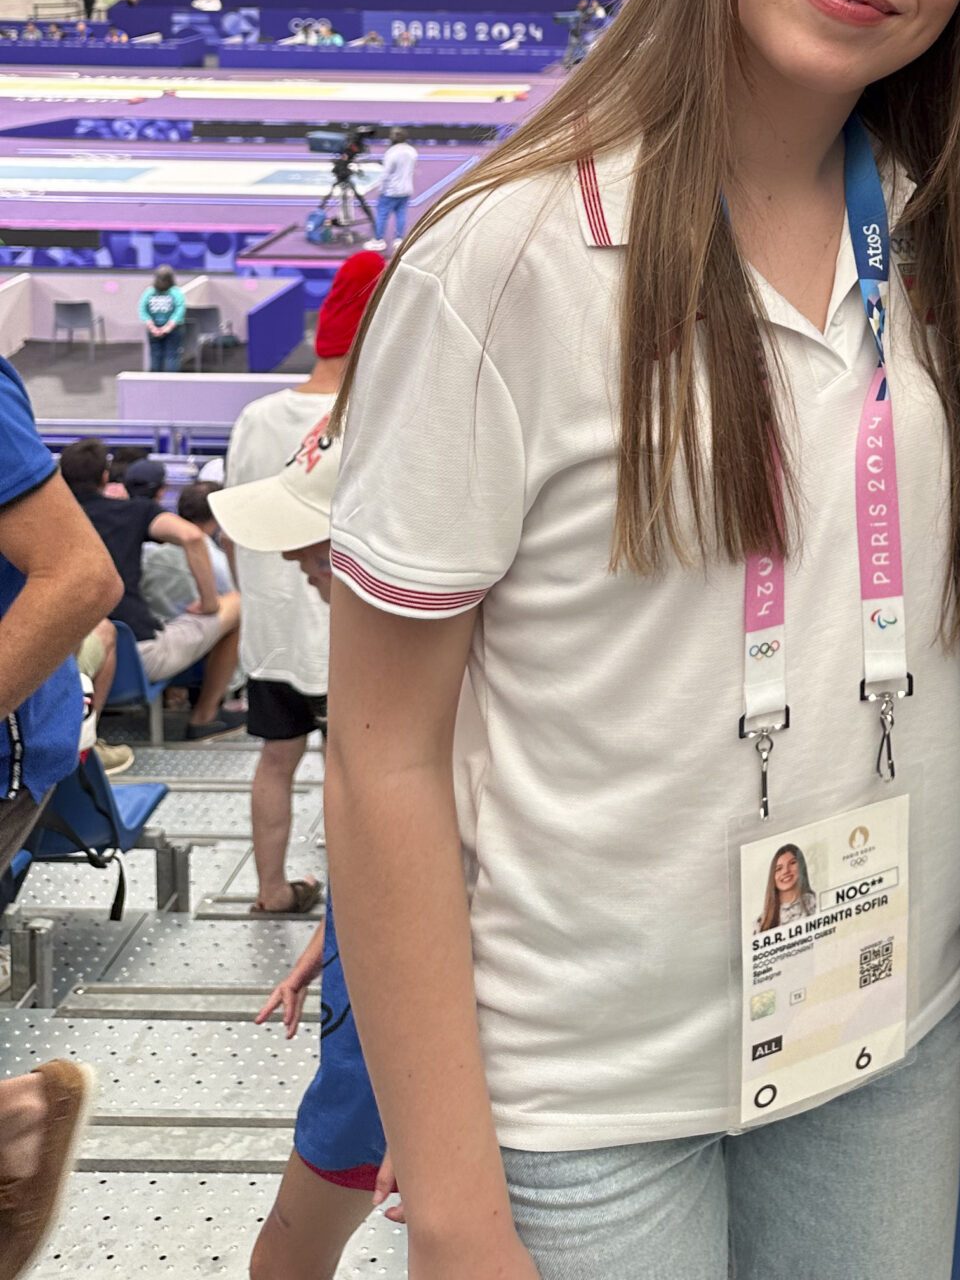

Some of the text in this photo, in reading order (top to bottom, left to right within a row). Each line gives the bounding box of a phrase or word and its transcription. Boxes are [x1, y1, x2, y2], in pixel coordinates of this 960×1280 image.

[863, 223, 883, 270] Atos
[867, 416, 885, 492] 2024
[757, 557, 774, 617] 024
[752, 895, 888, 951] S.A.R. LA INFANTA SOFIA
[755, 1042, 779, 1057] ALL
[856, 1047, 872, 1070] 6
